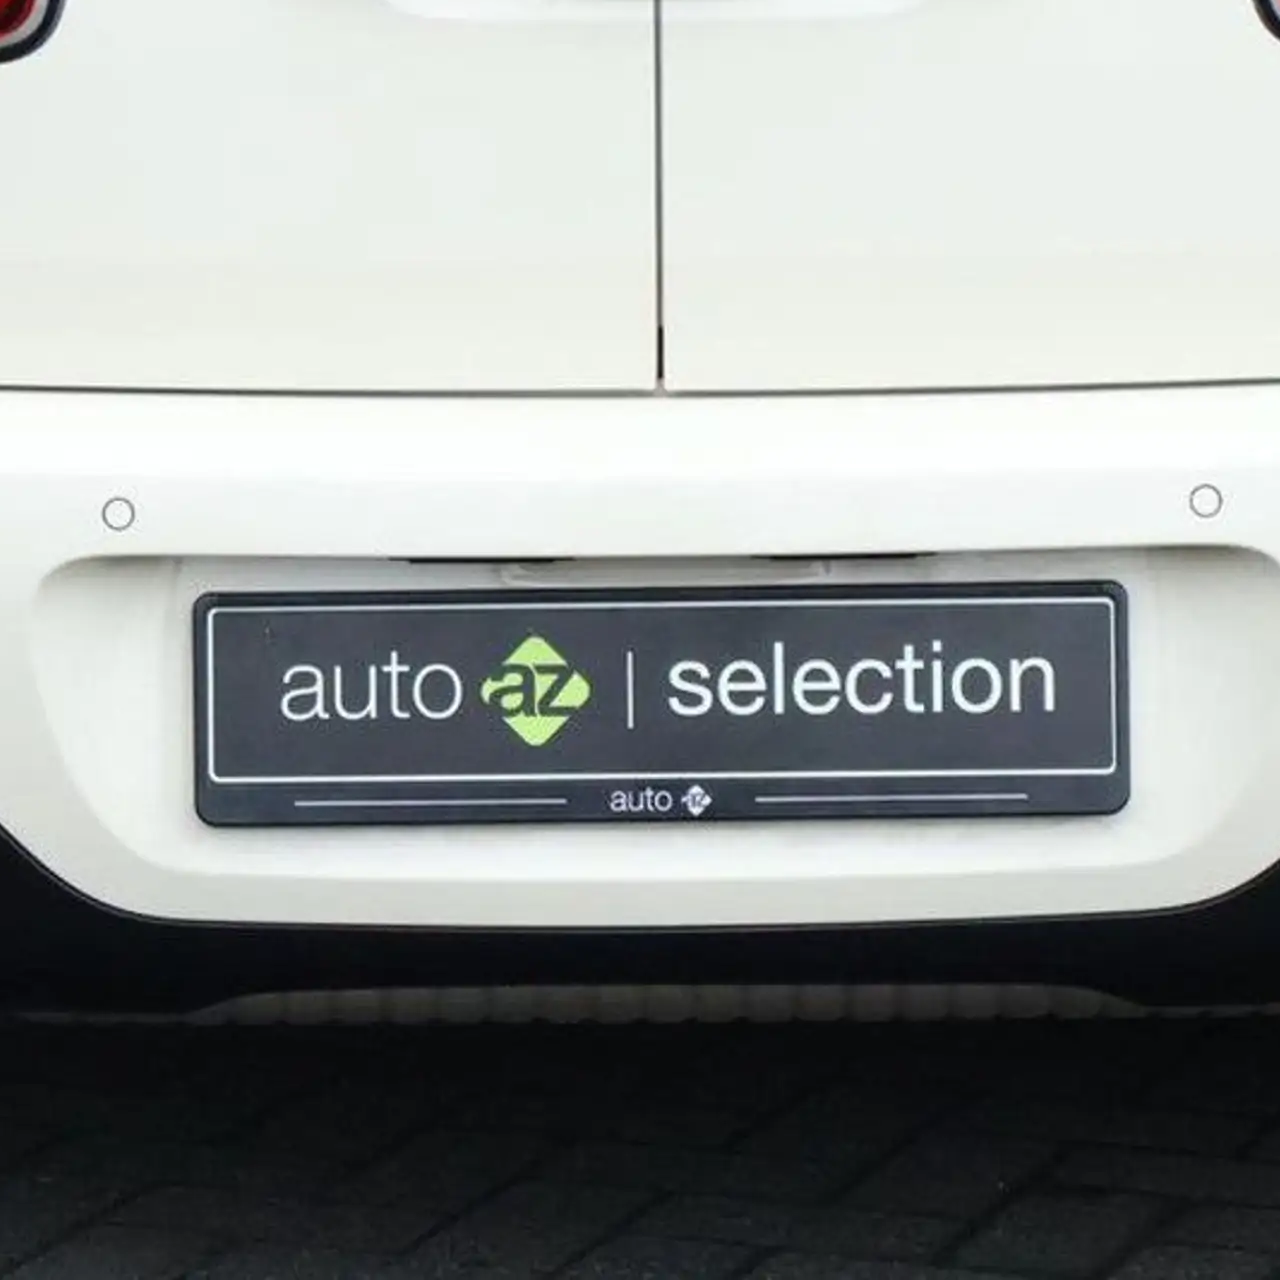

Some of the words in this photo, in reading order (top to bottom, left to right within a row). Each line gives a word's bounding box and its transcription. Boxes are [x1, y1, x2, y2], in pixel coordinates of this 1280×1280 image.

[280, 650, 463, 721] auto
[485, 663, 579, 718] az
[668, 639, 1055, 717] selection
[609, 786, 673, 812] auto
